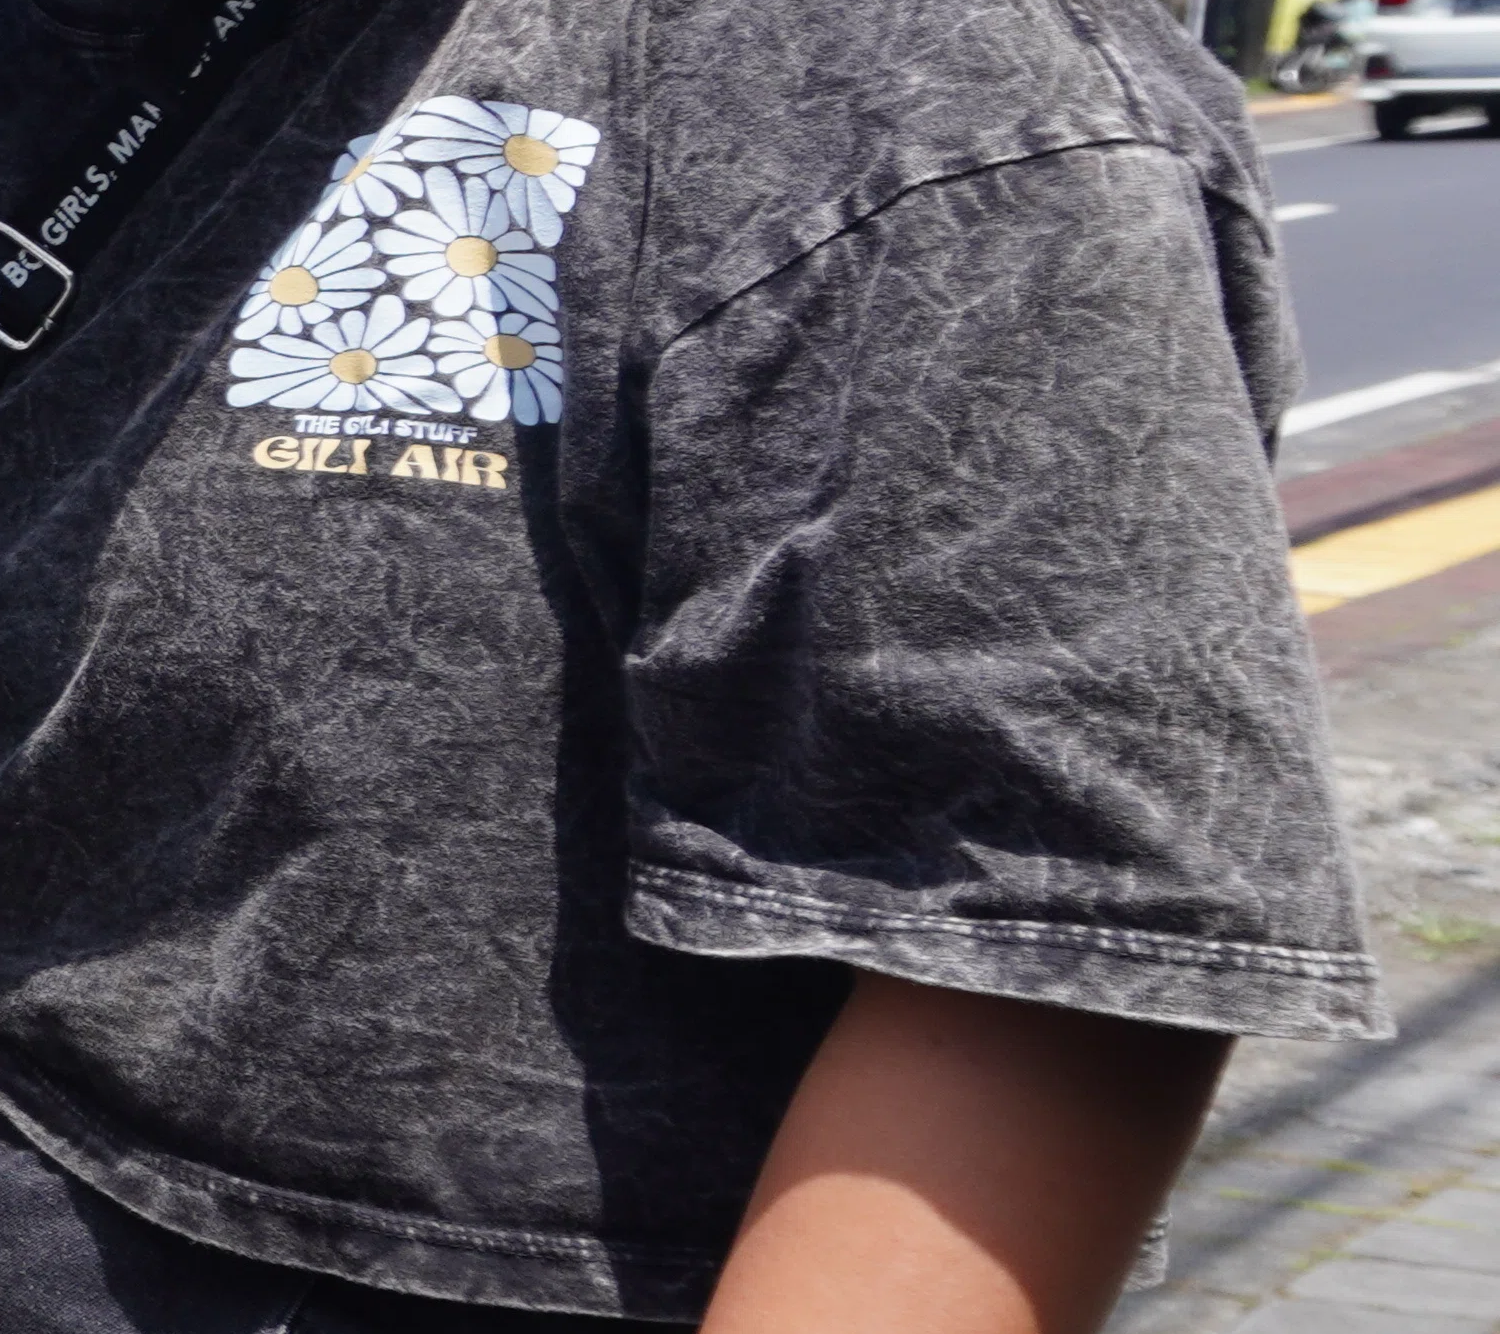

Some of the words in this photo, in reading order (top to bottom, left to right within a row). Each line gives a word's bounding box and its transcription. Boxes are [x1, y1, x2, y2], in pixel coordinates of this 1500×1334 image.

[293, 414, 340, 435] THE
[394, 419, 479, 444] STUFF
[253, 435, 372, 475] GILI
[391, 443, 509, 489] AIR
